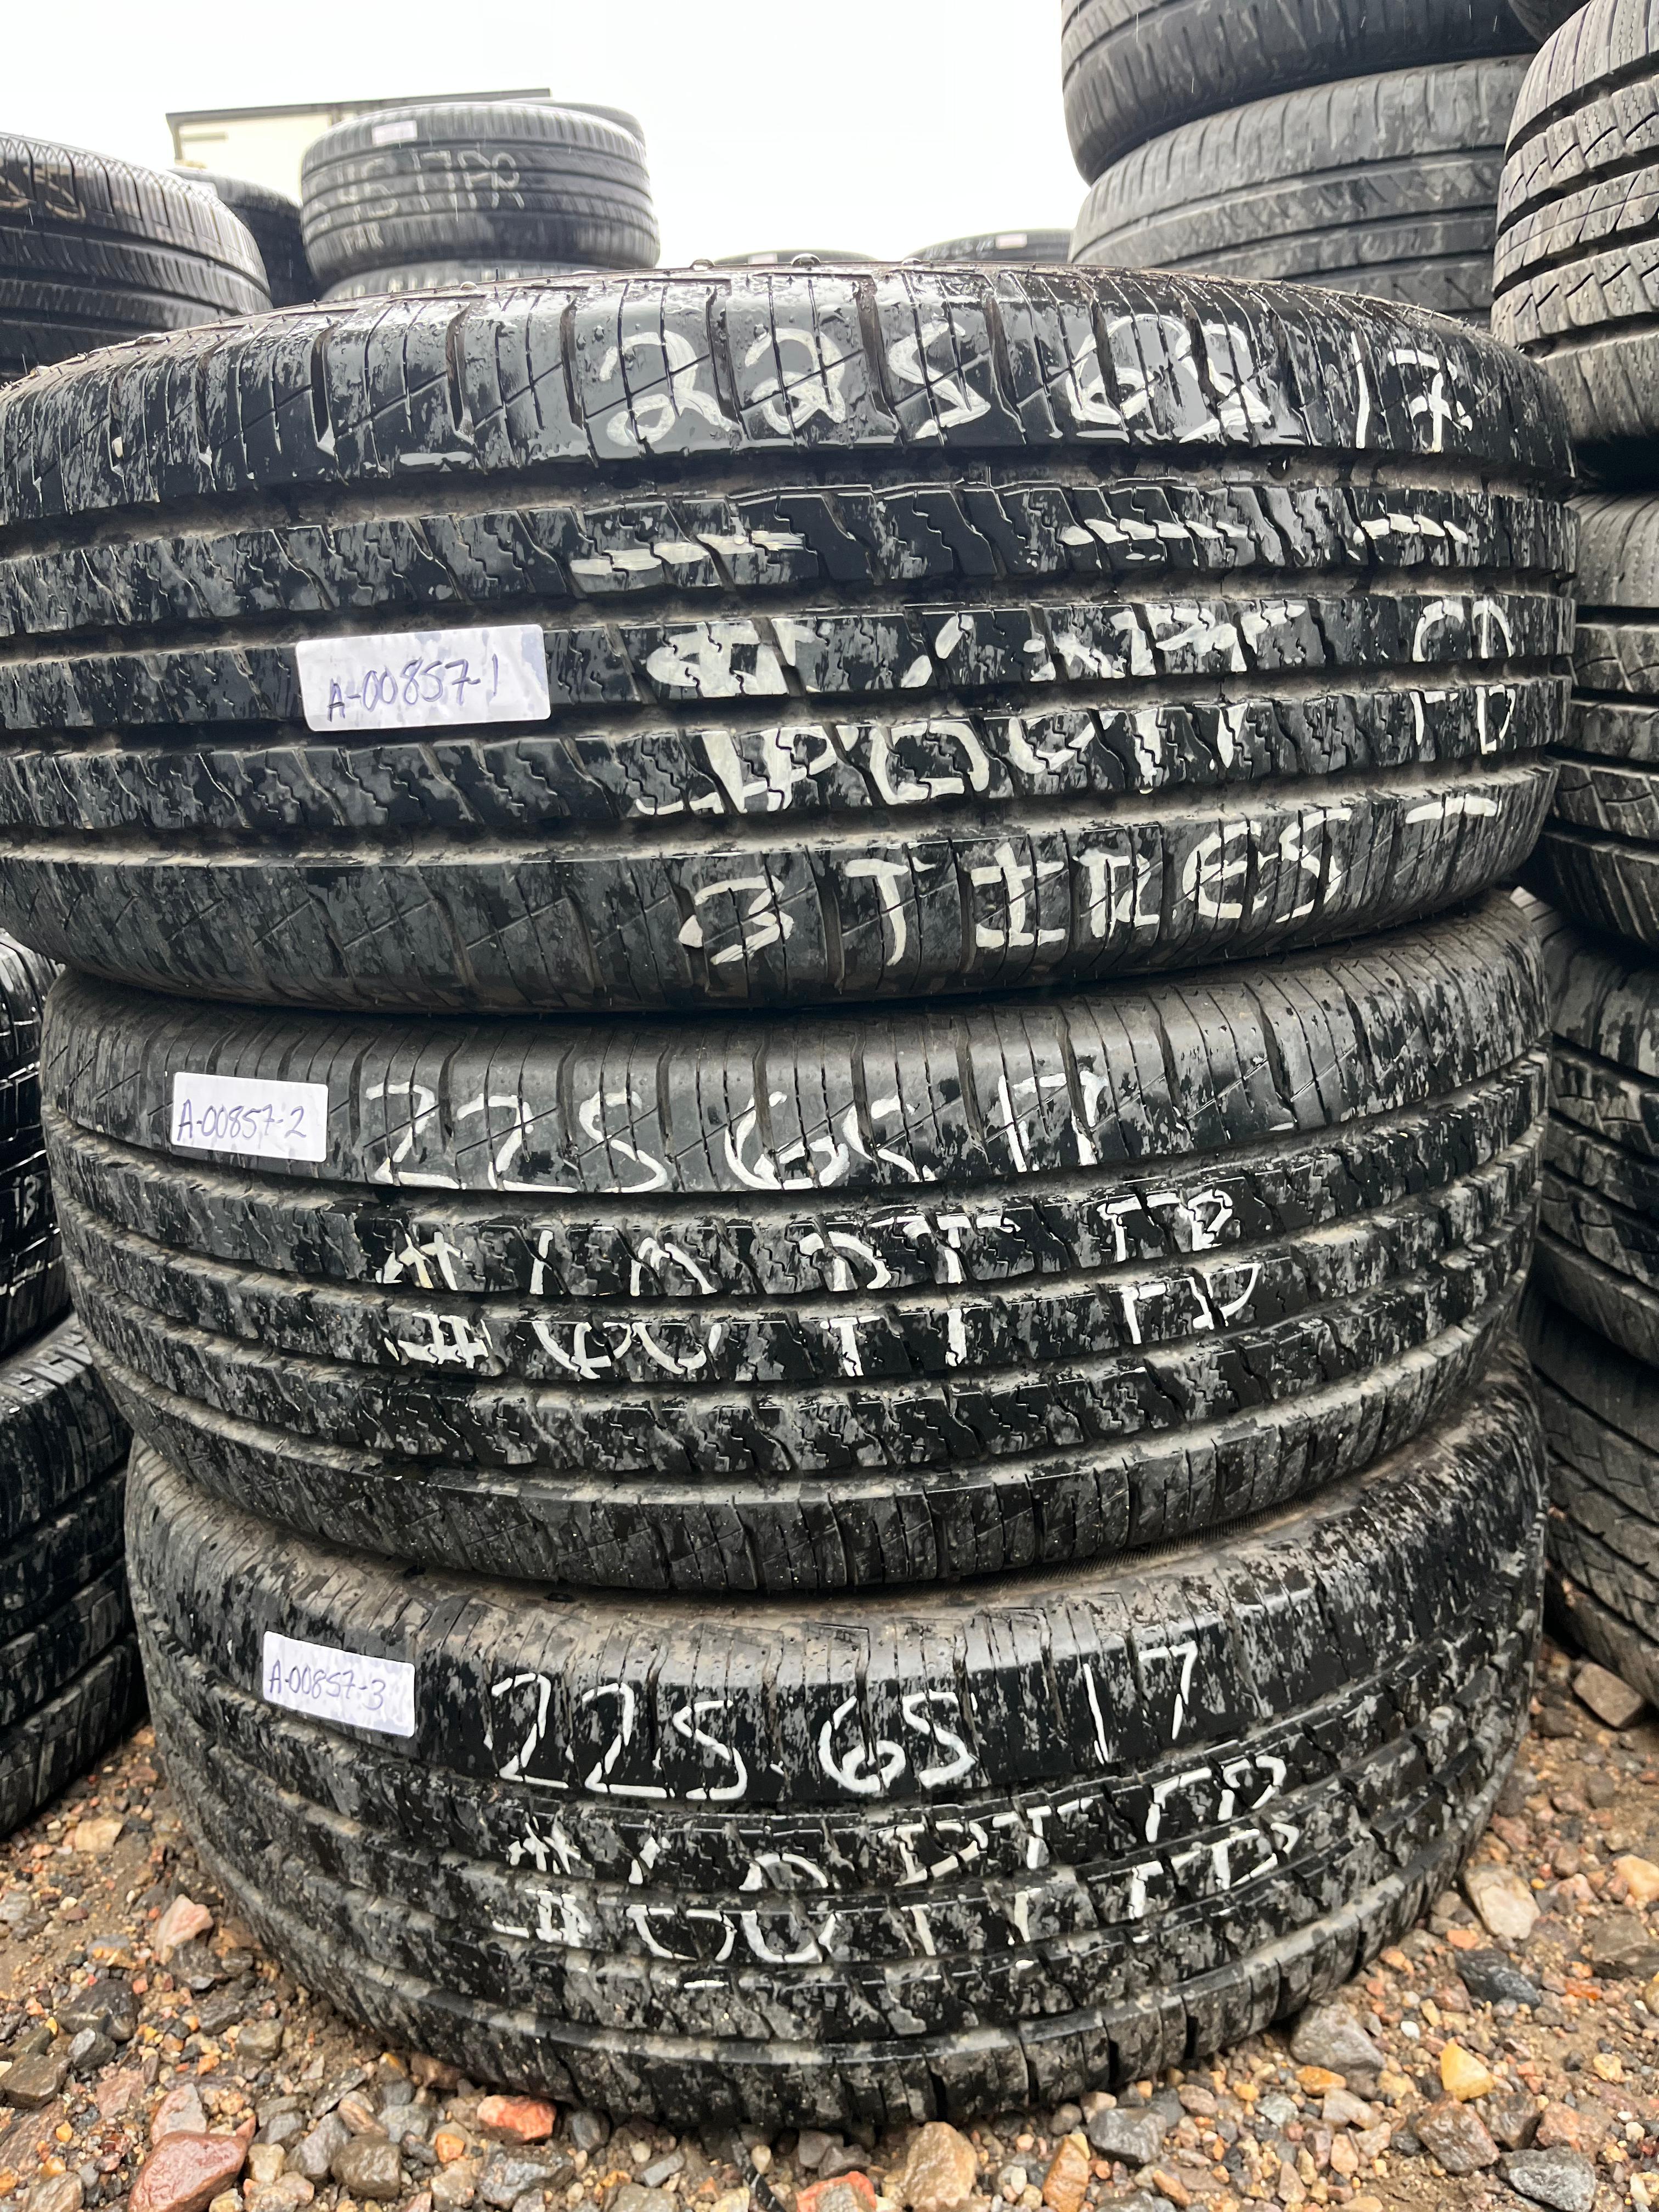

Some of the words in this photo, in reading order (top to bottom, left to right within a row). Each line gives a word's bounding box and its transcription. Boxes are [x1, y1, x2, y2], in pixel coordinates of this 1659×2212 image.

[597, 312, 991, 448] 225
[1063, 313, 1274, 444] 65
[1351, 328, 1475, 452] 17
[678, 874, 795, 967] 3
[177, 1099, 307, 1141] A-00857-2
[364, 1081, 670, 1193] 225
[723, 1092, 936, 1193] 65
[269, 1659, 386, 1711] A-00857-3
[484, 1670, 749, 1802] 225
[820, 1688, 980, 1795] 65
[1082, 1641, 1199, 1764] 17
